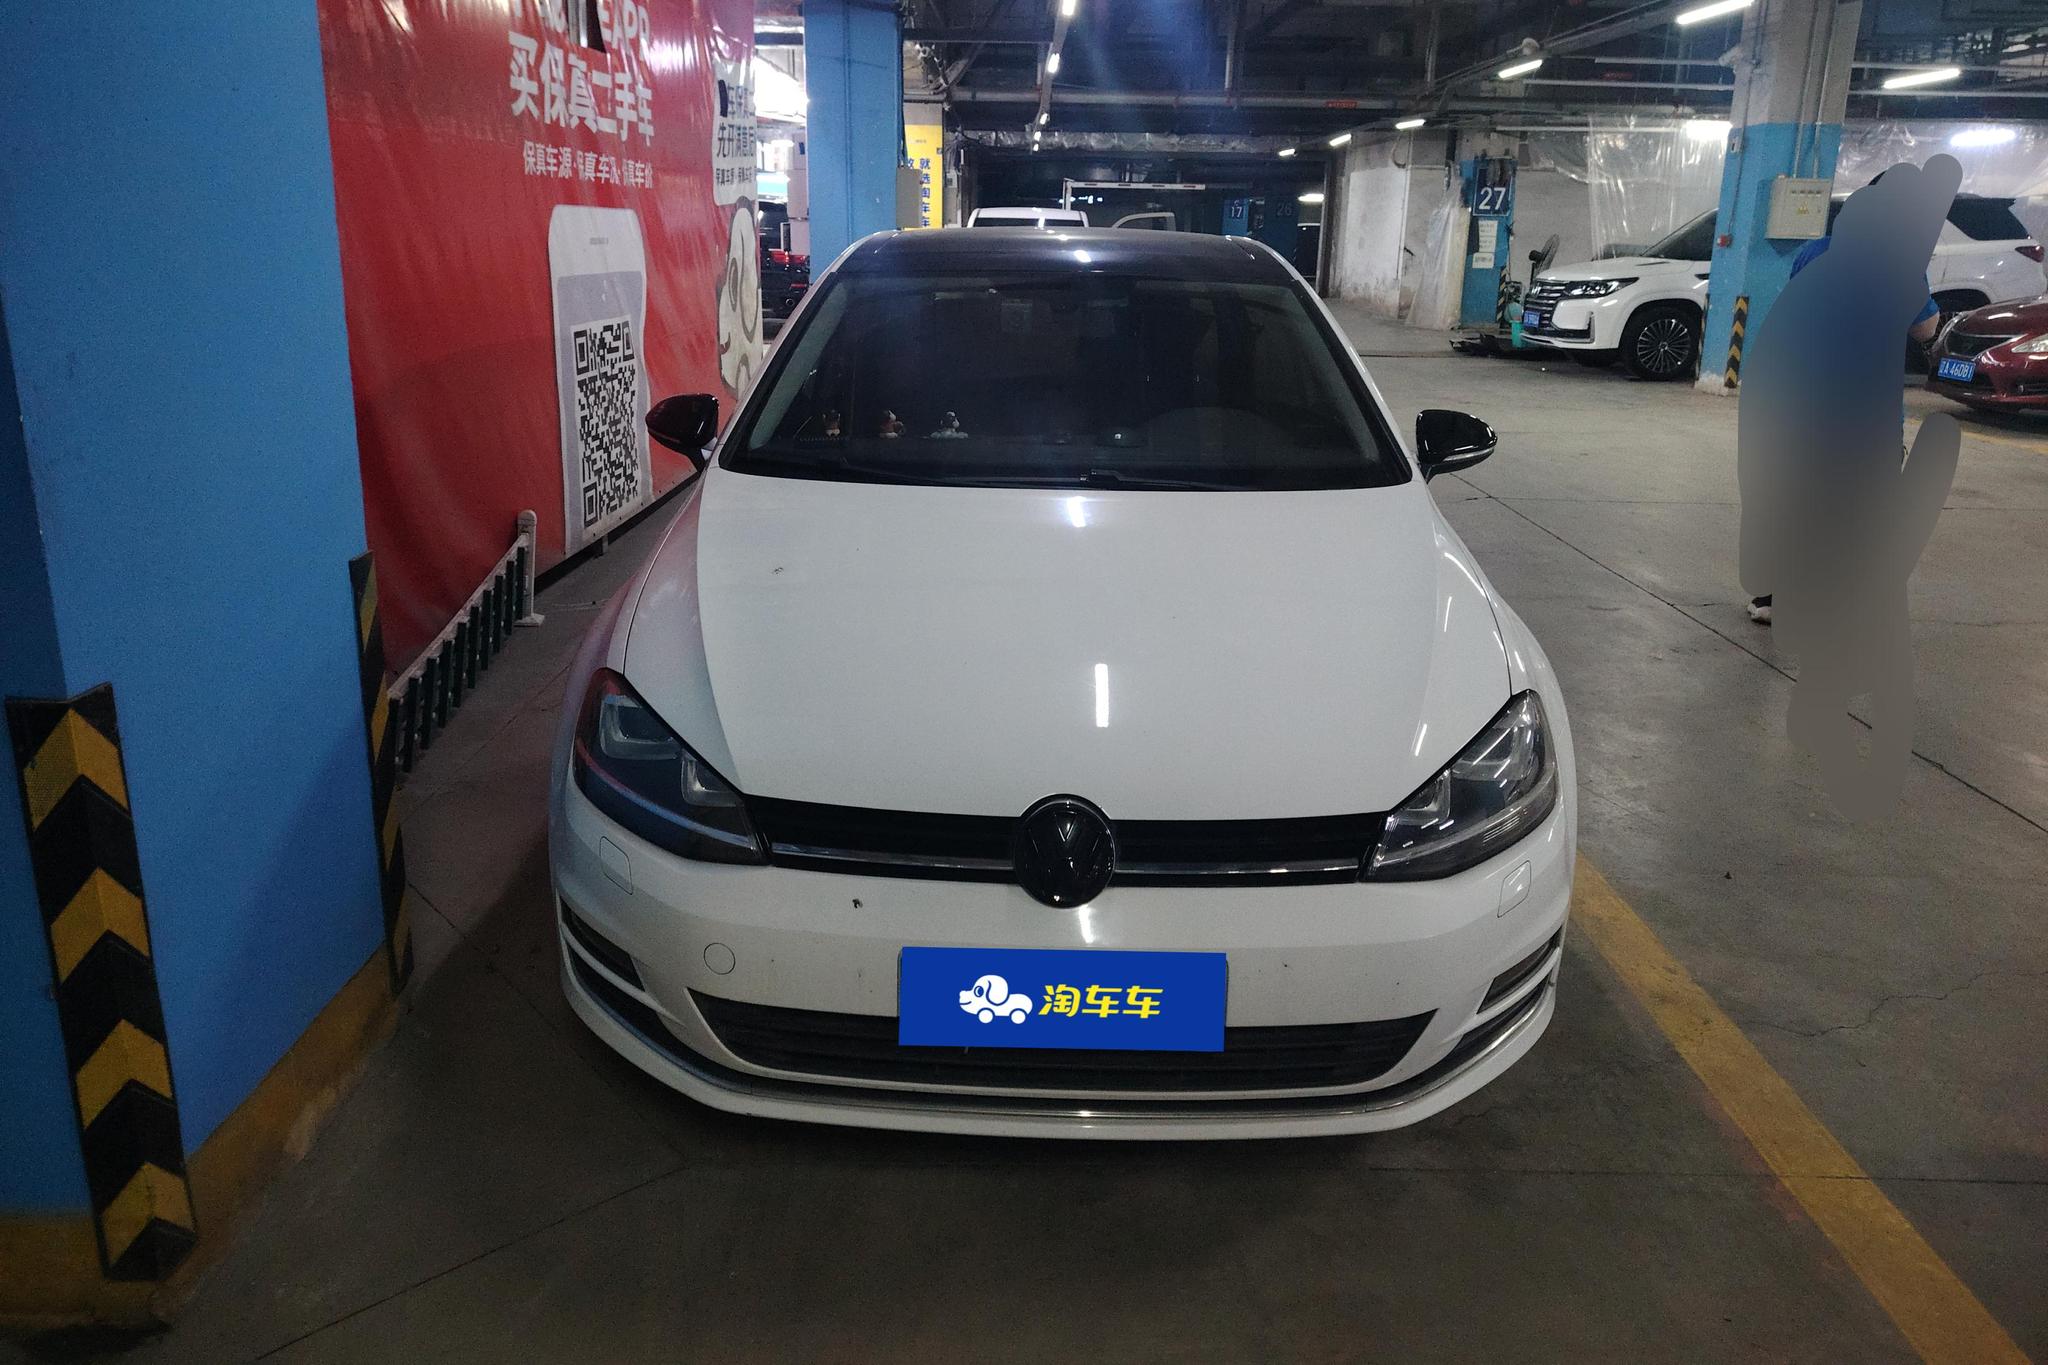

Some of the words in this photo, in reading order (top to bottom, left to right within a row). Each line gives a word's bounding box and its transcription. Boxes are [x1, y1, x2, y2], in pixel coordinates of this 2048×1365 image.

[508, 31, 654, 147] 买保真二手车
[1478, 186, 1506, 210] 27
[1231, 206, 1243, 218] 17
